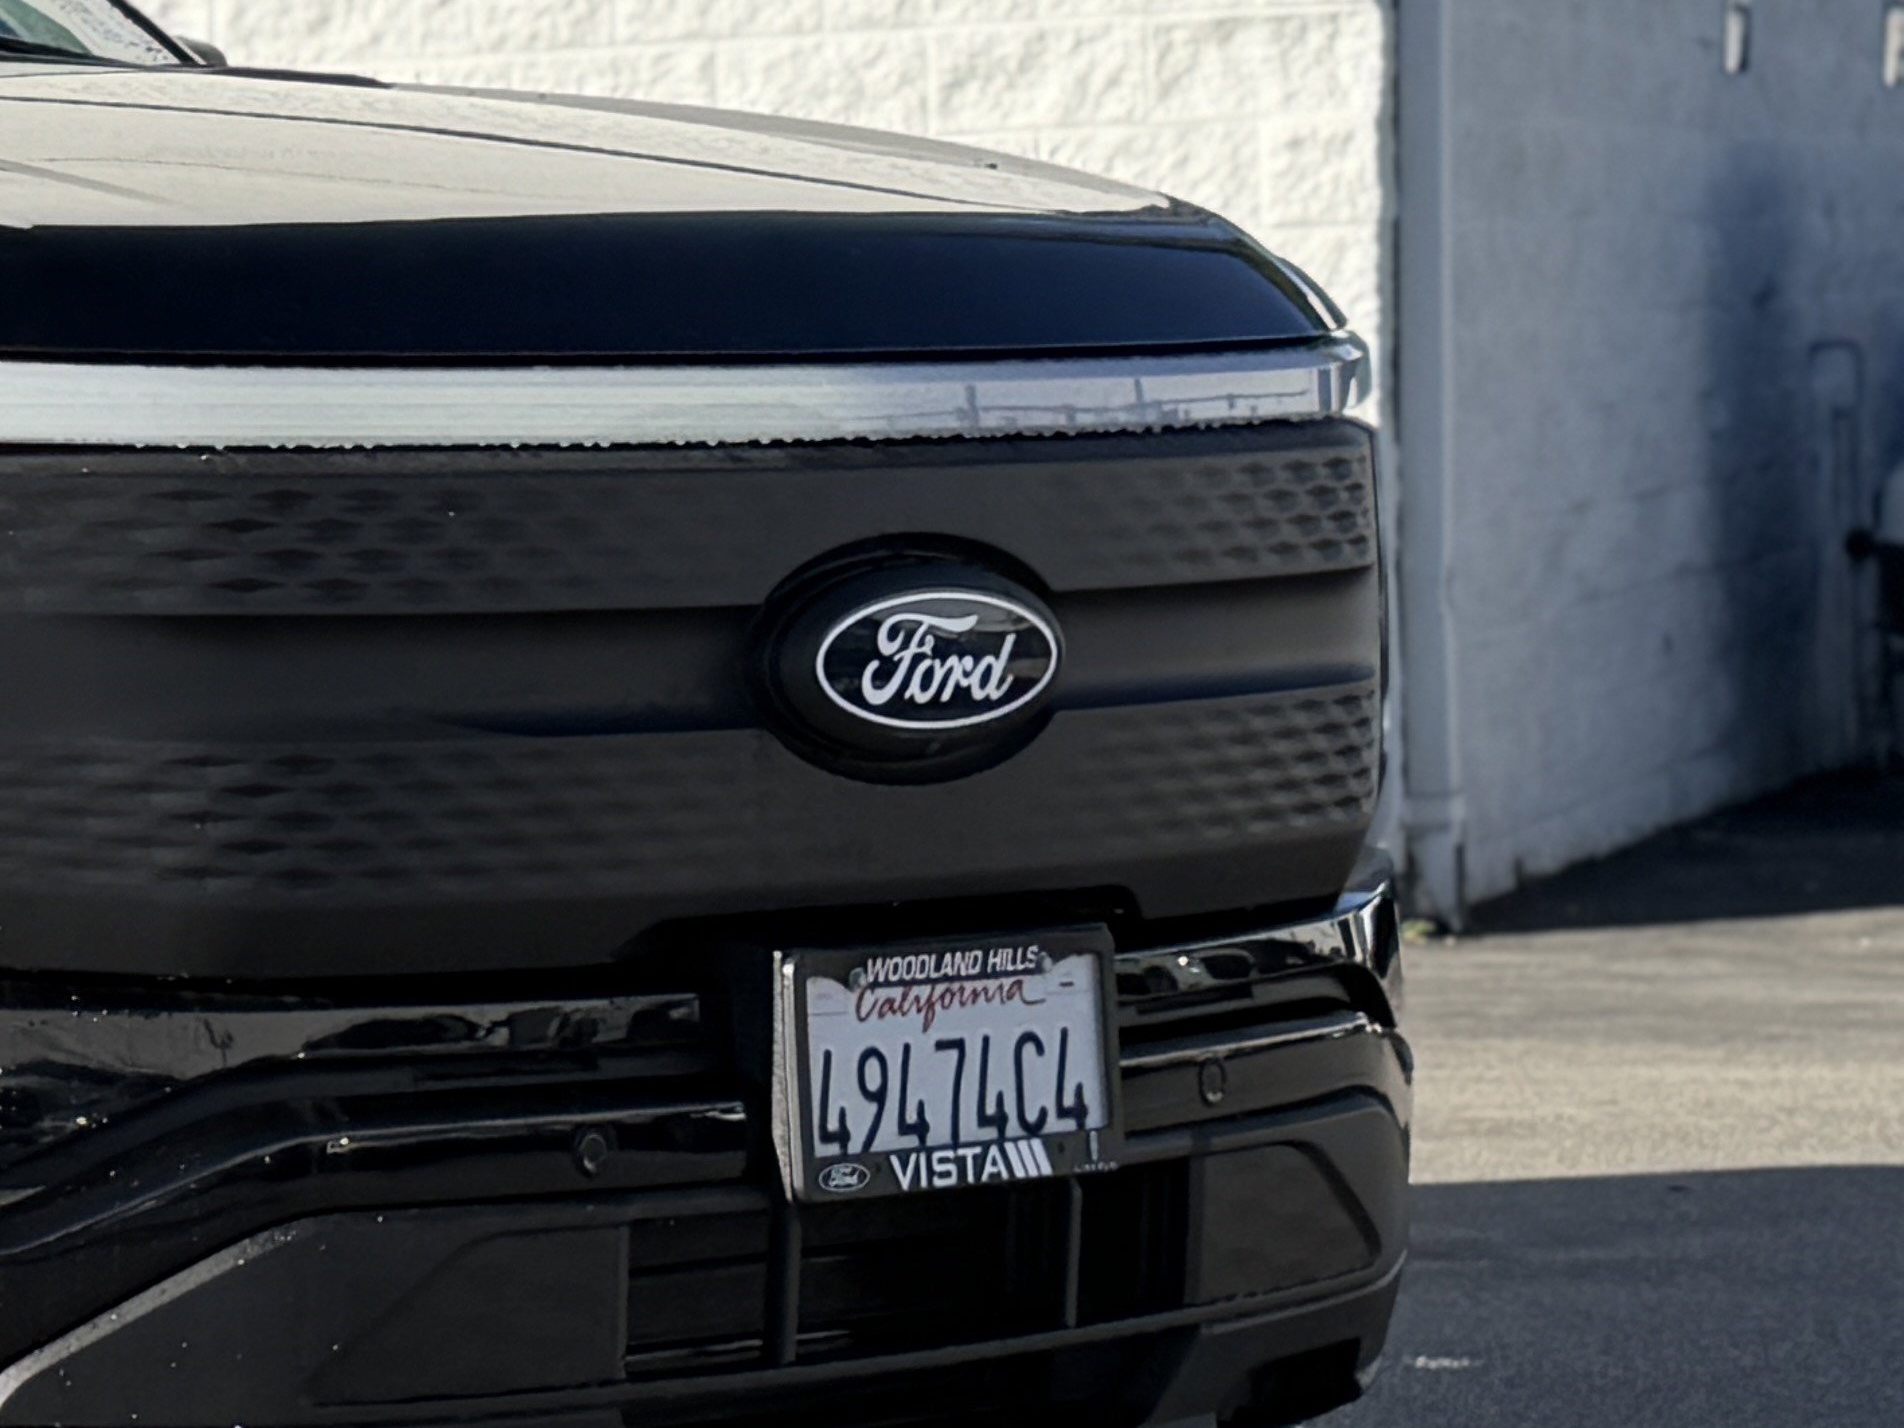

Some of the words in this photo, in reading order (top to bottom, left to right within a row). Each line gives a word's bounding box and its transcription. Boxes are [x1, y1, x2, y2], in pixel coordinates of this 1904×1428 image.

[861, 612, 1017, 706] Ford
[866, 950, 983, 983] WOODLAND
[988, 944, 1040, 972] HILLS
[854, 977, 1047, 1034] California
[818, 1026, 1090, 1155] 49474C4
[889, 1143, 1009, 1191] VISTA
